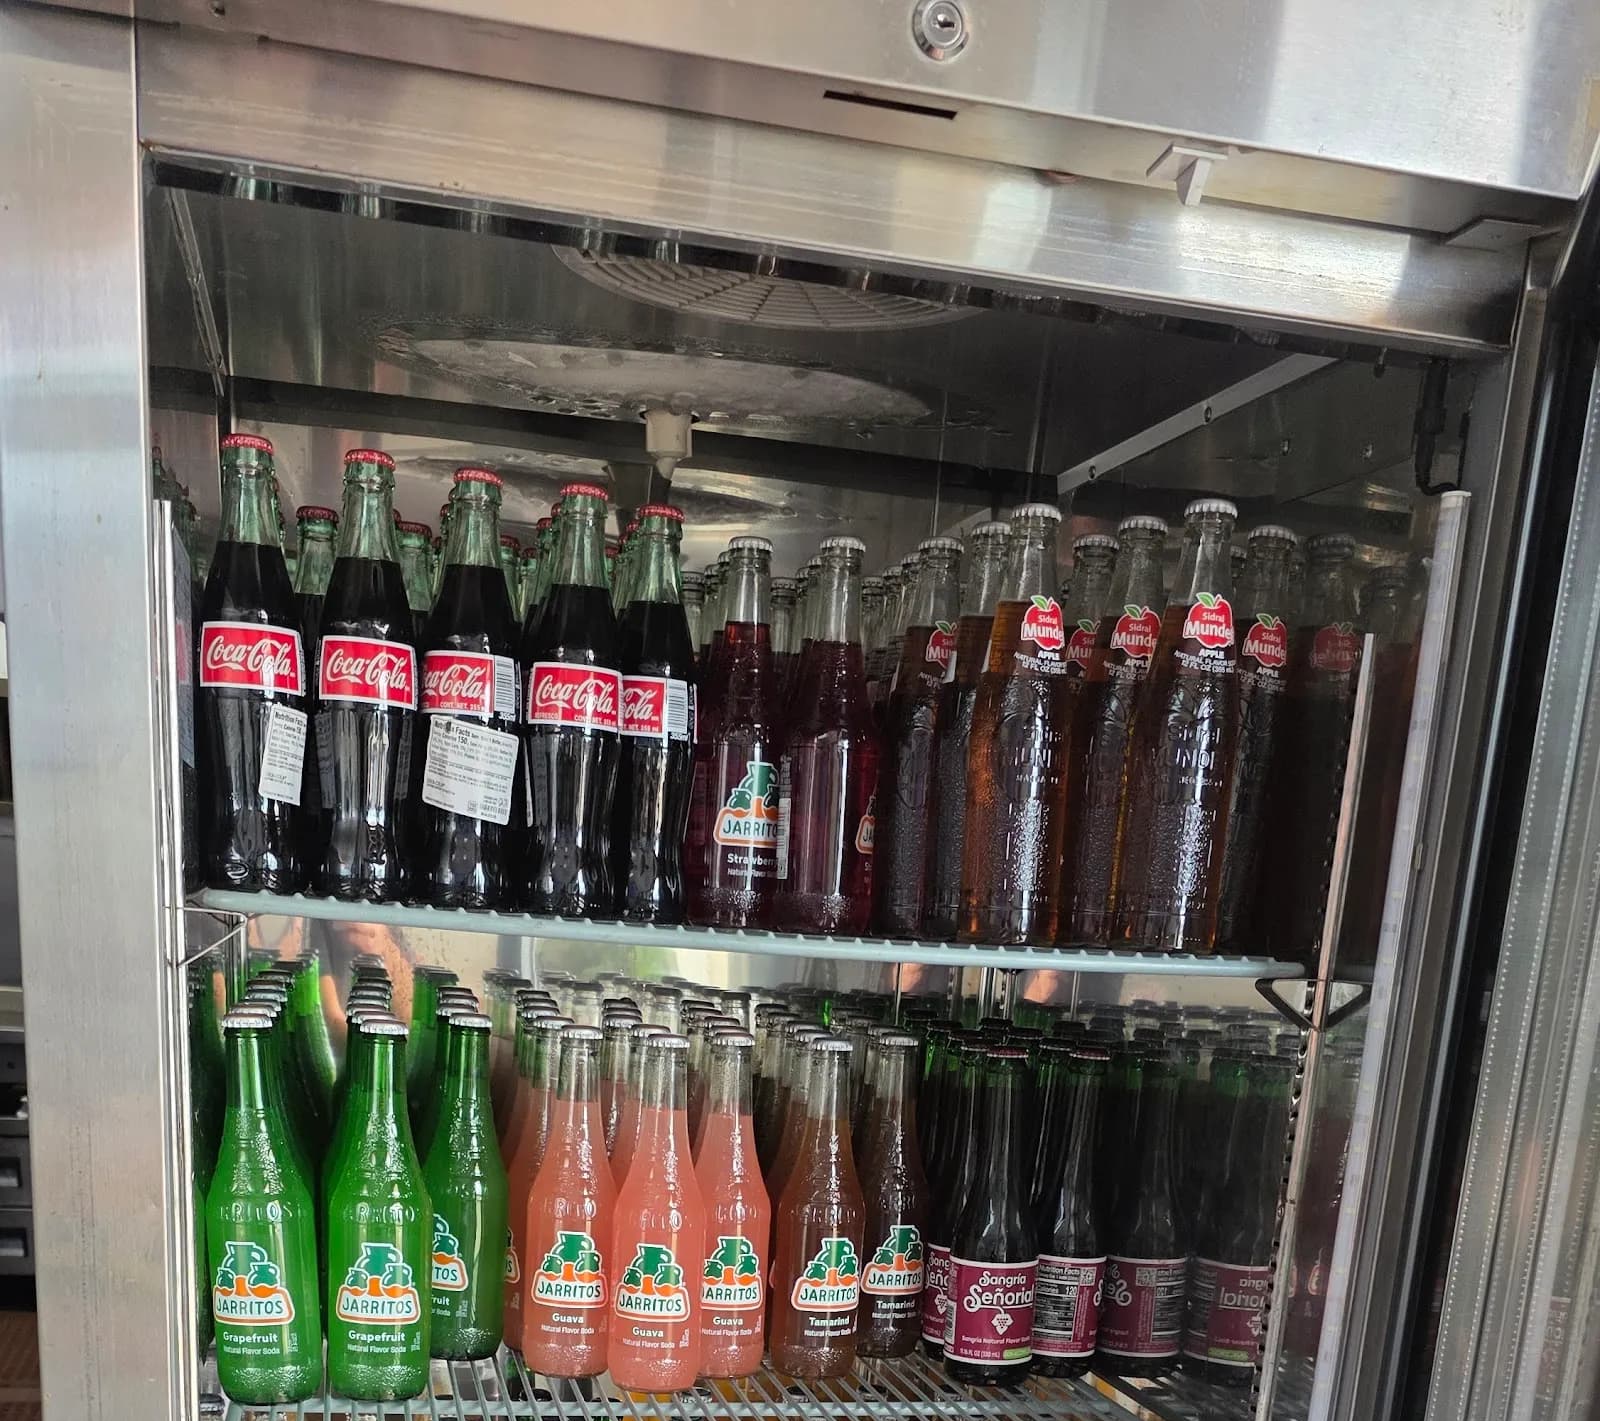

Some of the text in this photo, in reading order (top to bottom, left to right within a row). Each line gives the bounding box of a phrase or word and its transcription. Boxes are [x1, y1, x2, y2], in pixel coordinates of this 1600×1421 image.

[1038, 615, 1058, 625] Sidral
[1202, 612, 1225, 622] Sidral
[1023, 624, 1065, 641] Munde
[1129, 623, 1152, 632] Sidral
[1113, 632, 1158, 648] Munde
[207, 635, 292, 675] Coca-Cola
[1199, 650, 1225, 659] APPLE
[1245, 640, 1286, 659] Munde
[326, 648, 407, 689] Coca-Cola
[423, 663, 486, 698] ca-Cola
[536, 675, 615, 714] Coca-Cola
[723, 819, 778, 838] JARRITO
[928, 1251, 951, 1270] Sang
[869, 1271, 922, 1286] JARRITOS
[537, 1283, 601, 1298] JARRITOS
[800, 1286, 857, 1302] JARRITOS
[1065, 1285, 1078, 1296] 120
[217, 1298, 283, 1315] JARRITOS
[342, 1299, 412, 1314] JARRITOS
[619, 1297, 682, 1312] JARRITOS
[876, 1300, 915, 1311] Tamarind
[552, 1313, 584, 1324] Guava
[712, 1316, 744, 1327] Guava
[809, 1316, 850, 1328] Tamarind
[223, 1331, 279, 1345] Grapefruit
[348, 1330, 406, 1344] Grapefruit
[632, 1326, 664, 1338] Guava
[242, 1346, 262, 1355] Flavor
[262, 1346, 280, 1355] Soda
[369, 1345, 389, 1354] Flavor
